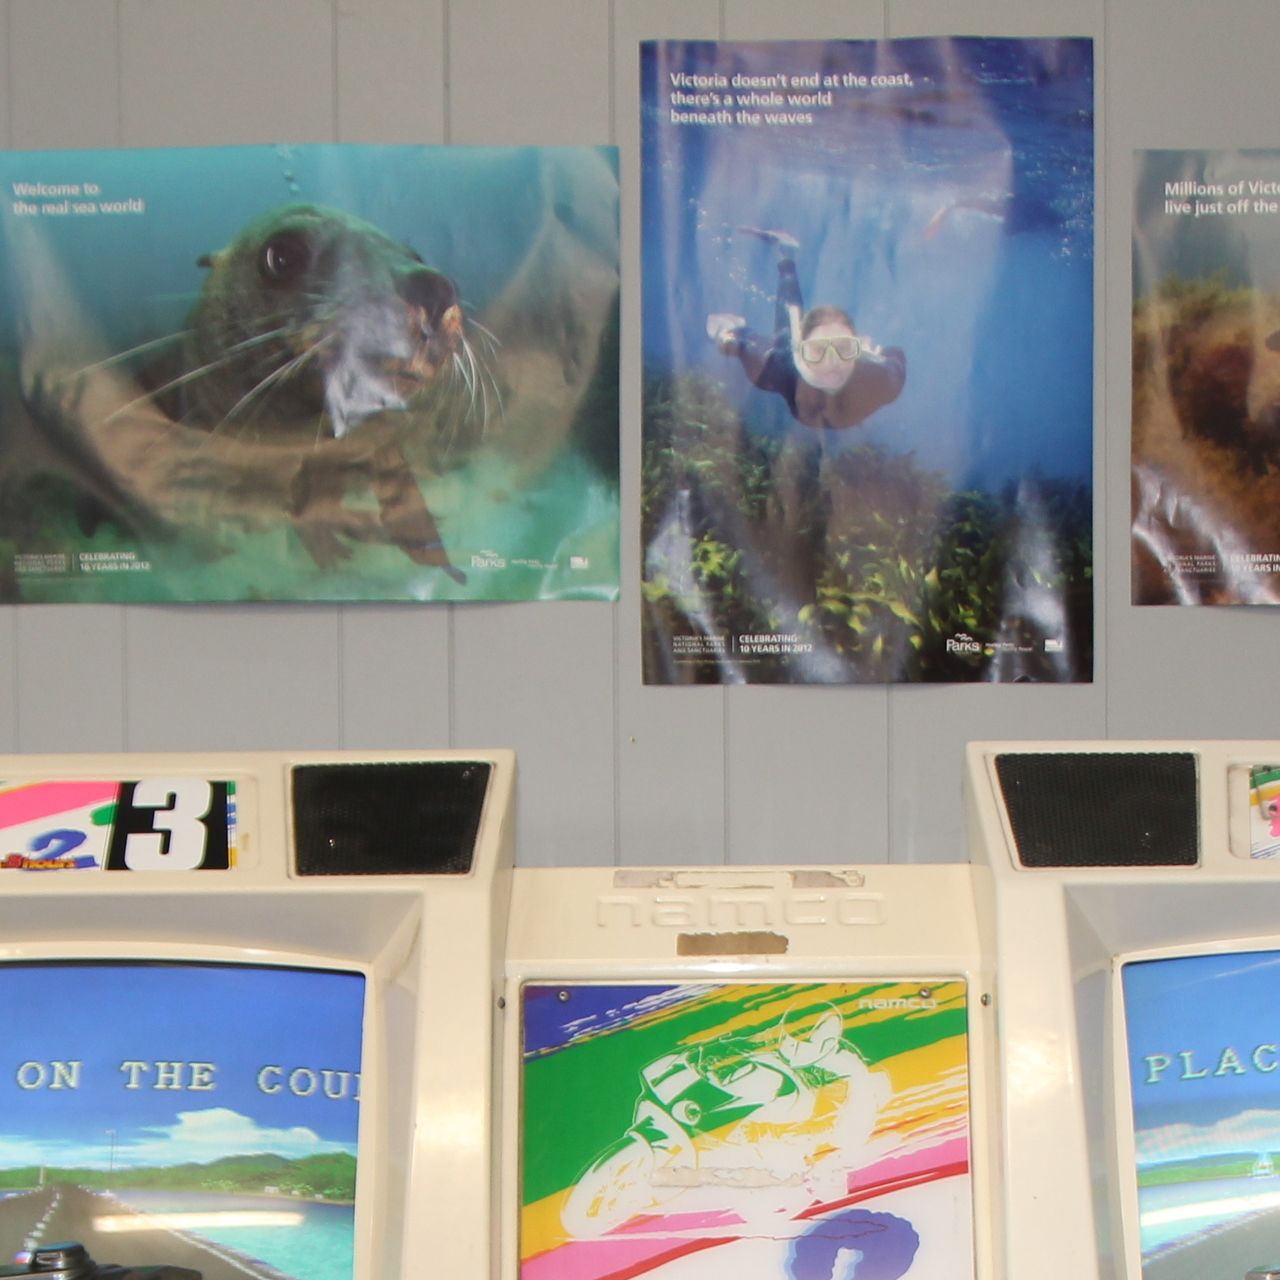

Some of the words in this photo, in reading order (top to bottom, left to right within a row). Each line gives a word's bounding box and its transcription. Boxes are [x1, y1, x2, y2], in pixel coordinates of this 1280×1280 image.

[670, 72, 727, 88] Victoria
[731, 73, 787, 88] doesn't
[791, 72, 819, 87] end
[823, 74, 839, 87] at
[841, 72, 867, 87] the
[870, 73, 913, 88] coast,
[670, 92, 721, 106] there's
[723, 94, 732, 106] a
[736, 92, 784, 106] whole
[787, 91, 833, 106] world
[670, 109, 732, 124] beneath
[735, 109, 761, 124] the
[764, 112, 813, 124] waves
[12, 182, 80, 196] Welcome
[83, 182, 100, 195] to
[1164, 182, 1224, 196] Millions
[1227, 180, 1245, 195] of
[13, 200, 38, 215] the
[41, 199, 69, 214] real
[72, 202, 97, 213] sea
[100, 198, 144, 213] world
[1164, 200, 1191, 213] live
[1194, 200, 1223, 218] just
[1226, 199, 1249, 214] off
[1253, 198, 1278, 213] the
[739, 634, 798, 643] CELEBRATING
[946, 639, 980, 652] Parks
[740, 644, 750, 654] 10
[752, 644, 780, 653] YEARS
[781, 644, 791, 653] IN
[124, 777, 213, 871] 3
[597, 894, 888, 928] namco
[858, 998, 937, 1010] namco
[17, 1060, 83, 1091] ON
[120, 1060, 217, 1092] THE
